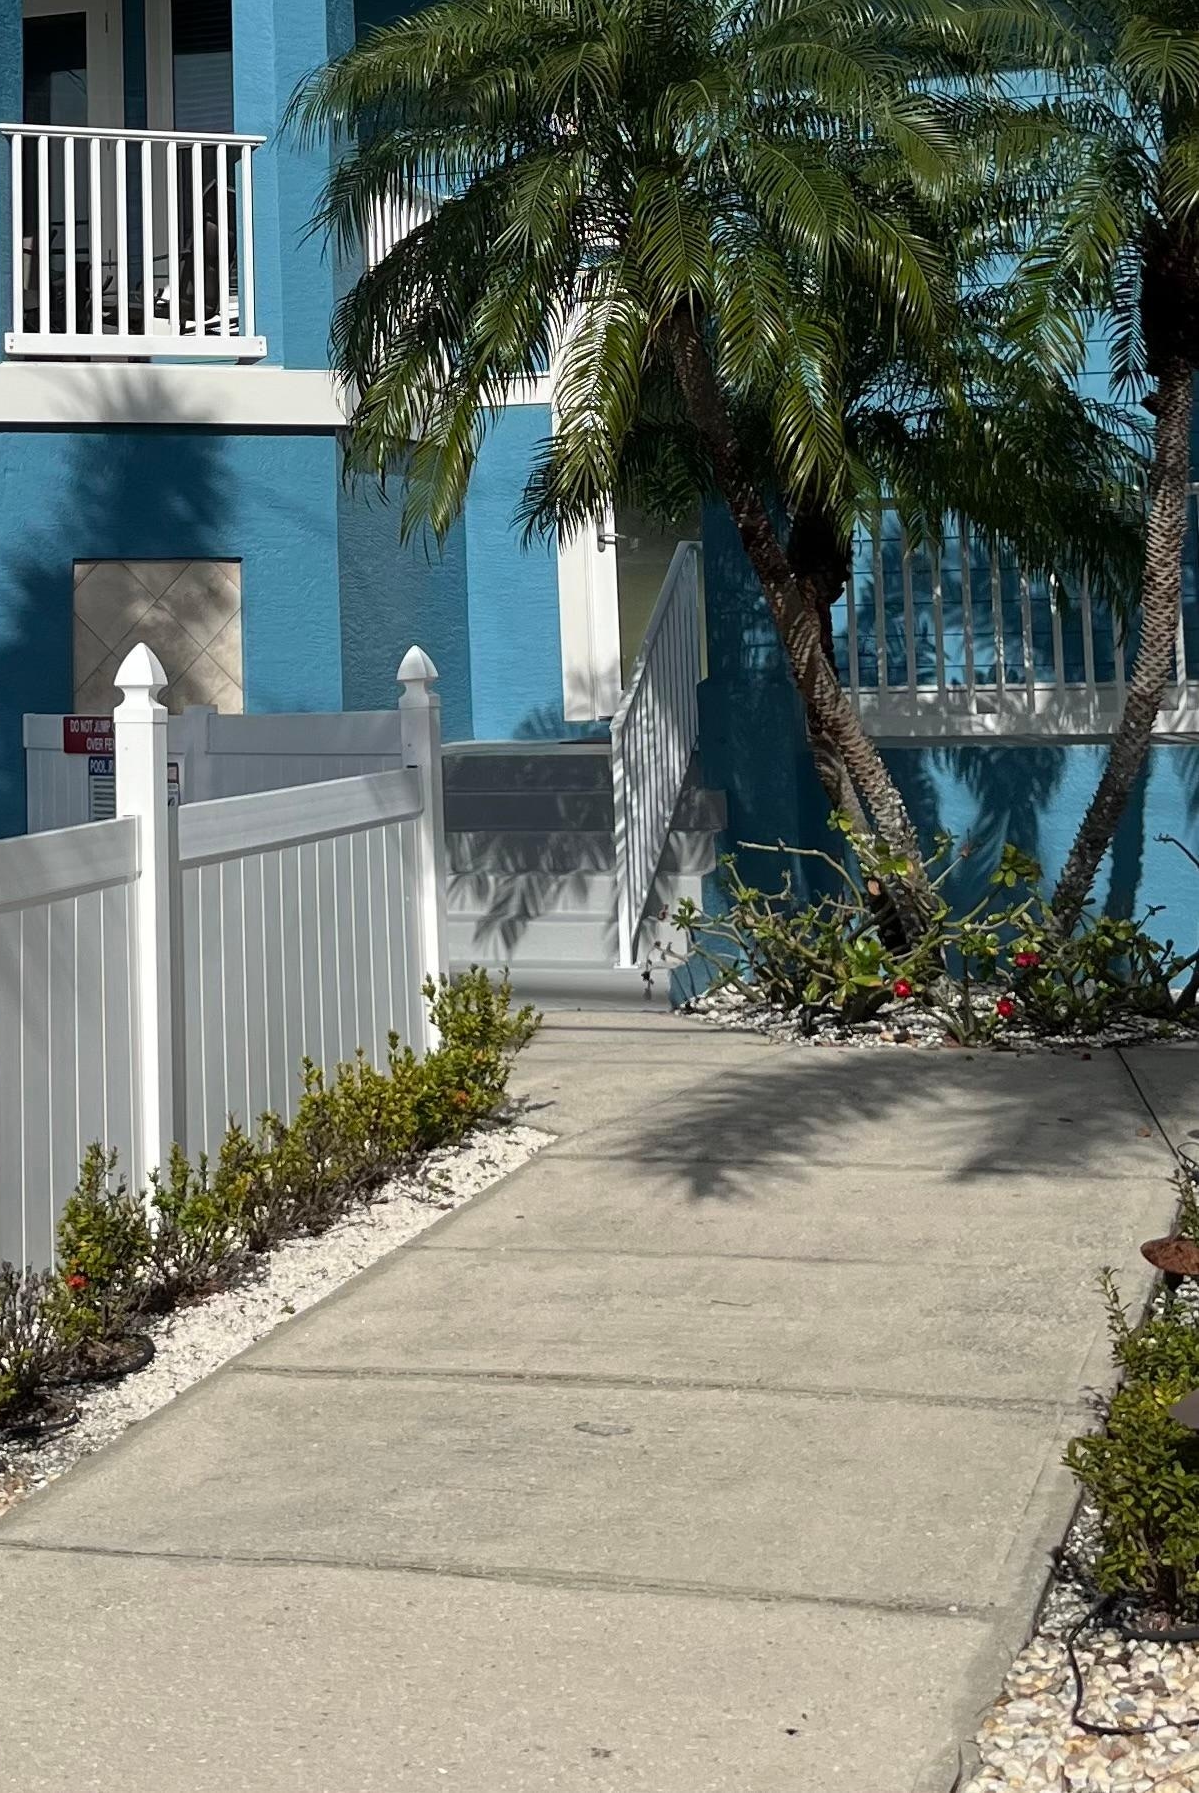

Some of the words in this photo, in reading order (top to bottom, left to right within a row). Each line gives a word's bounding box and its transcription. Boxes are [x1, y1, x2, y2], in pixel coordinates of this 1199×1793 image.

[70, 719, 79, 733] DO
[80, 719, 93, 733] NOT
[94, 720, 111, 733] JUMP
[86, 737, 103, 750] OVER
[90, 759, 107, 773] POOL
